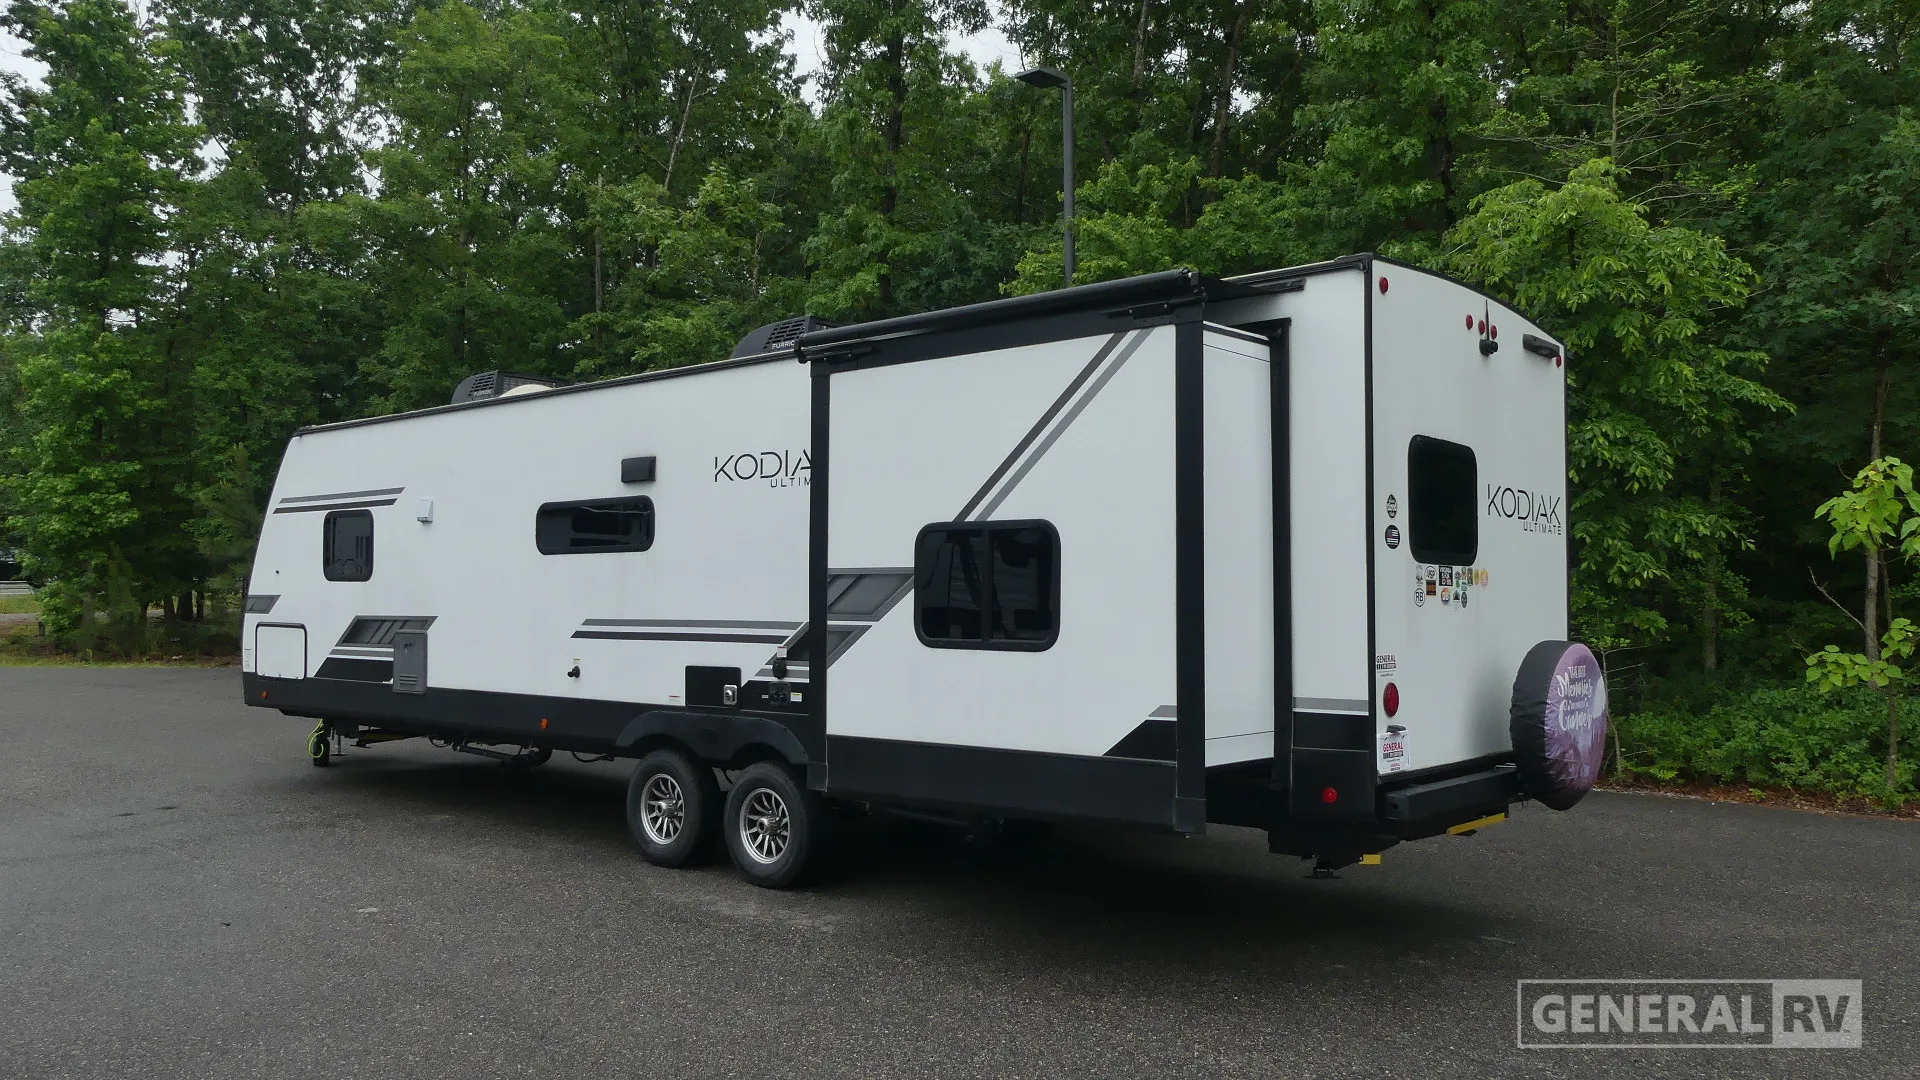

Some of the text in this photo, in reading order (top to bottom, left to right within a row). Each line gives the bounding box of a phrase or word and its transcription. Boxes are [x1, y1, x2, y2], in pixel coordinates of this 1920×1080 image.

[714, 448, 811, 482] KODIA
[770, 476, 811, 488] ULTIM
[1487, 483, 1561, 525] KODIAK
[1523, 521, 1562, 536] ULTIMATE
[1376, 654, 1396, 664] GENERAL
[1382, 741, 1404, 753] GENERAL
